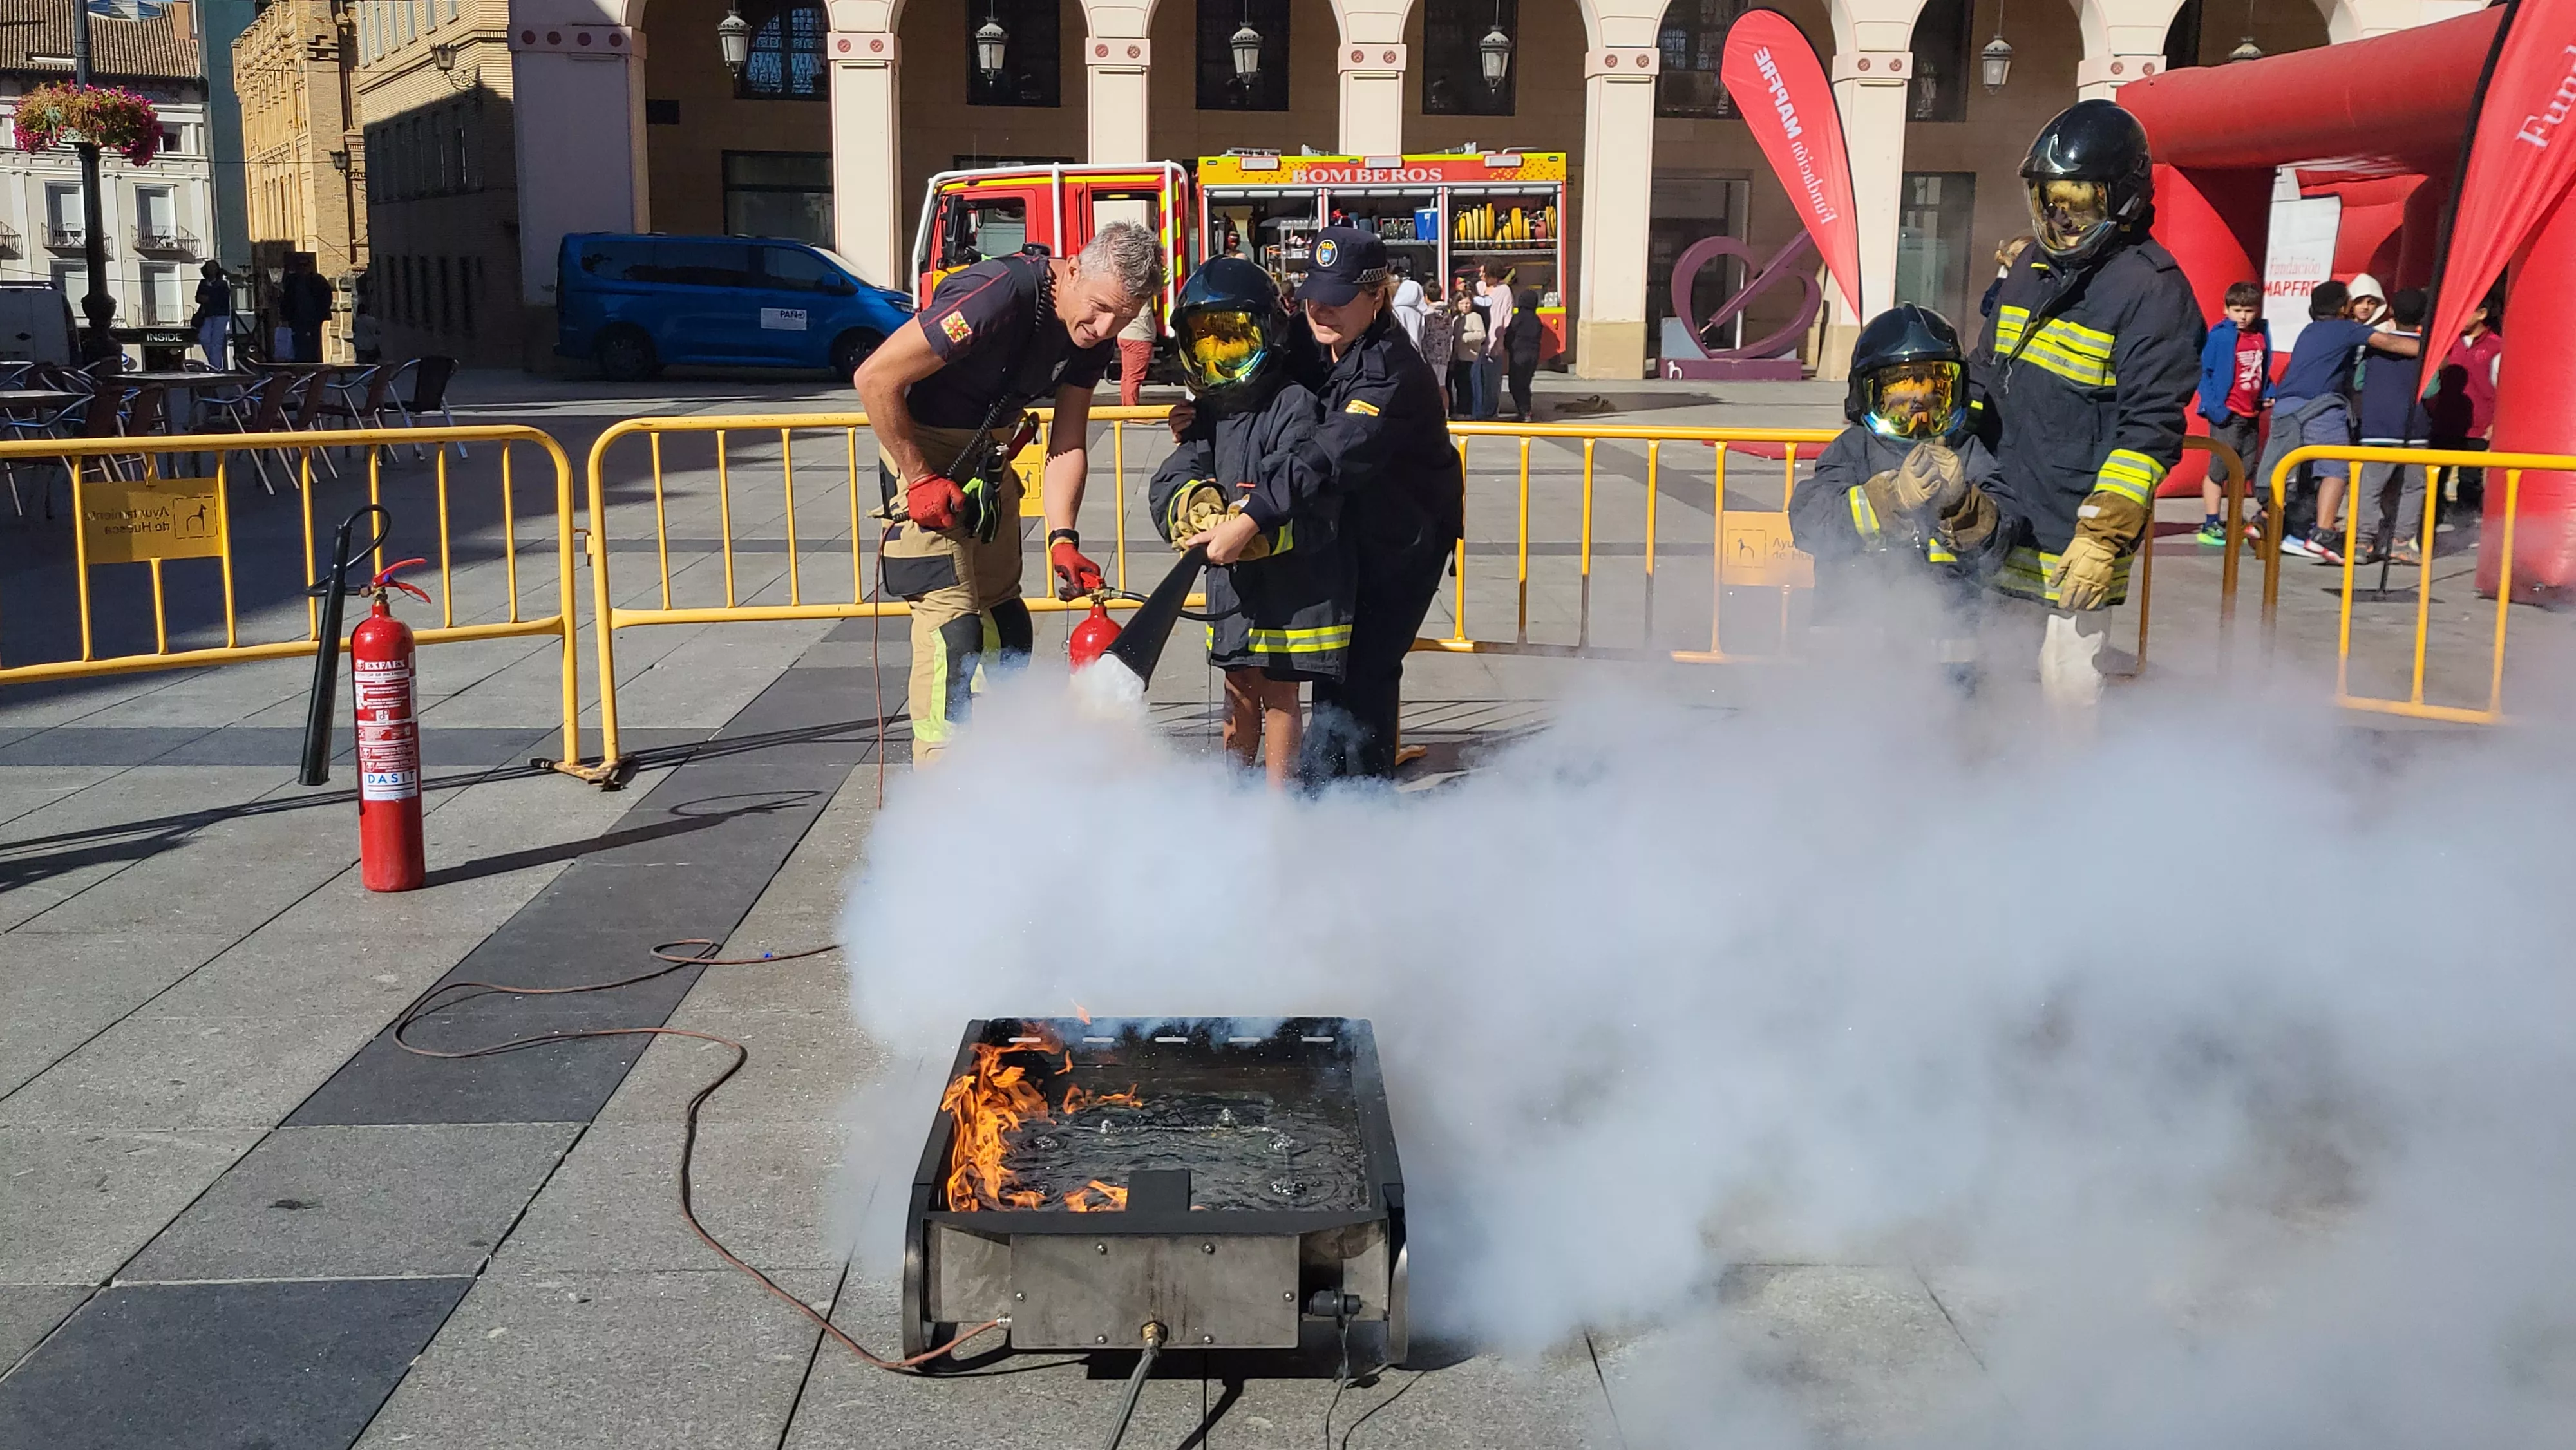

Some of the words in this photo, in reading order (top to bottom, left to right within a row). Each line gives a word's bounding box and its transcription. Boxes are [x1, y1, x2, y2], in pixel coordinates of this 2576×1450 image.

[1292, 167, 1443, 184] BOMBEROS
[147, 332, 183, 341] INSIDE
[368, 771, 414, 784] DASIT
